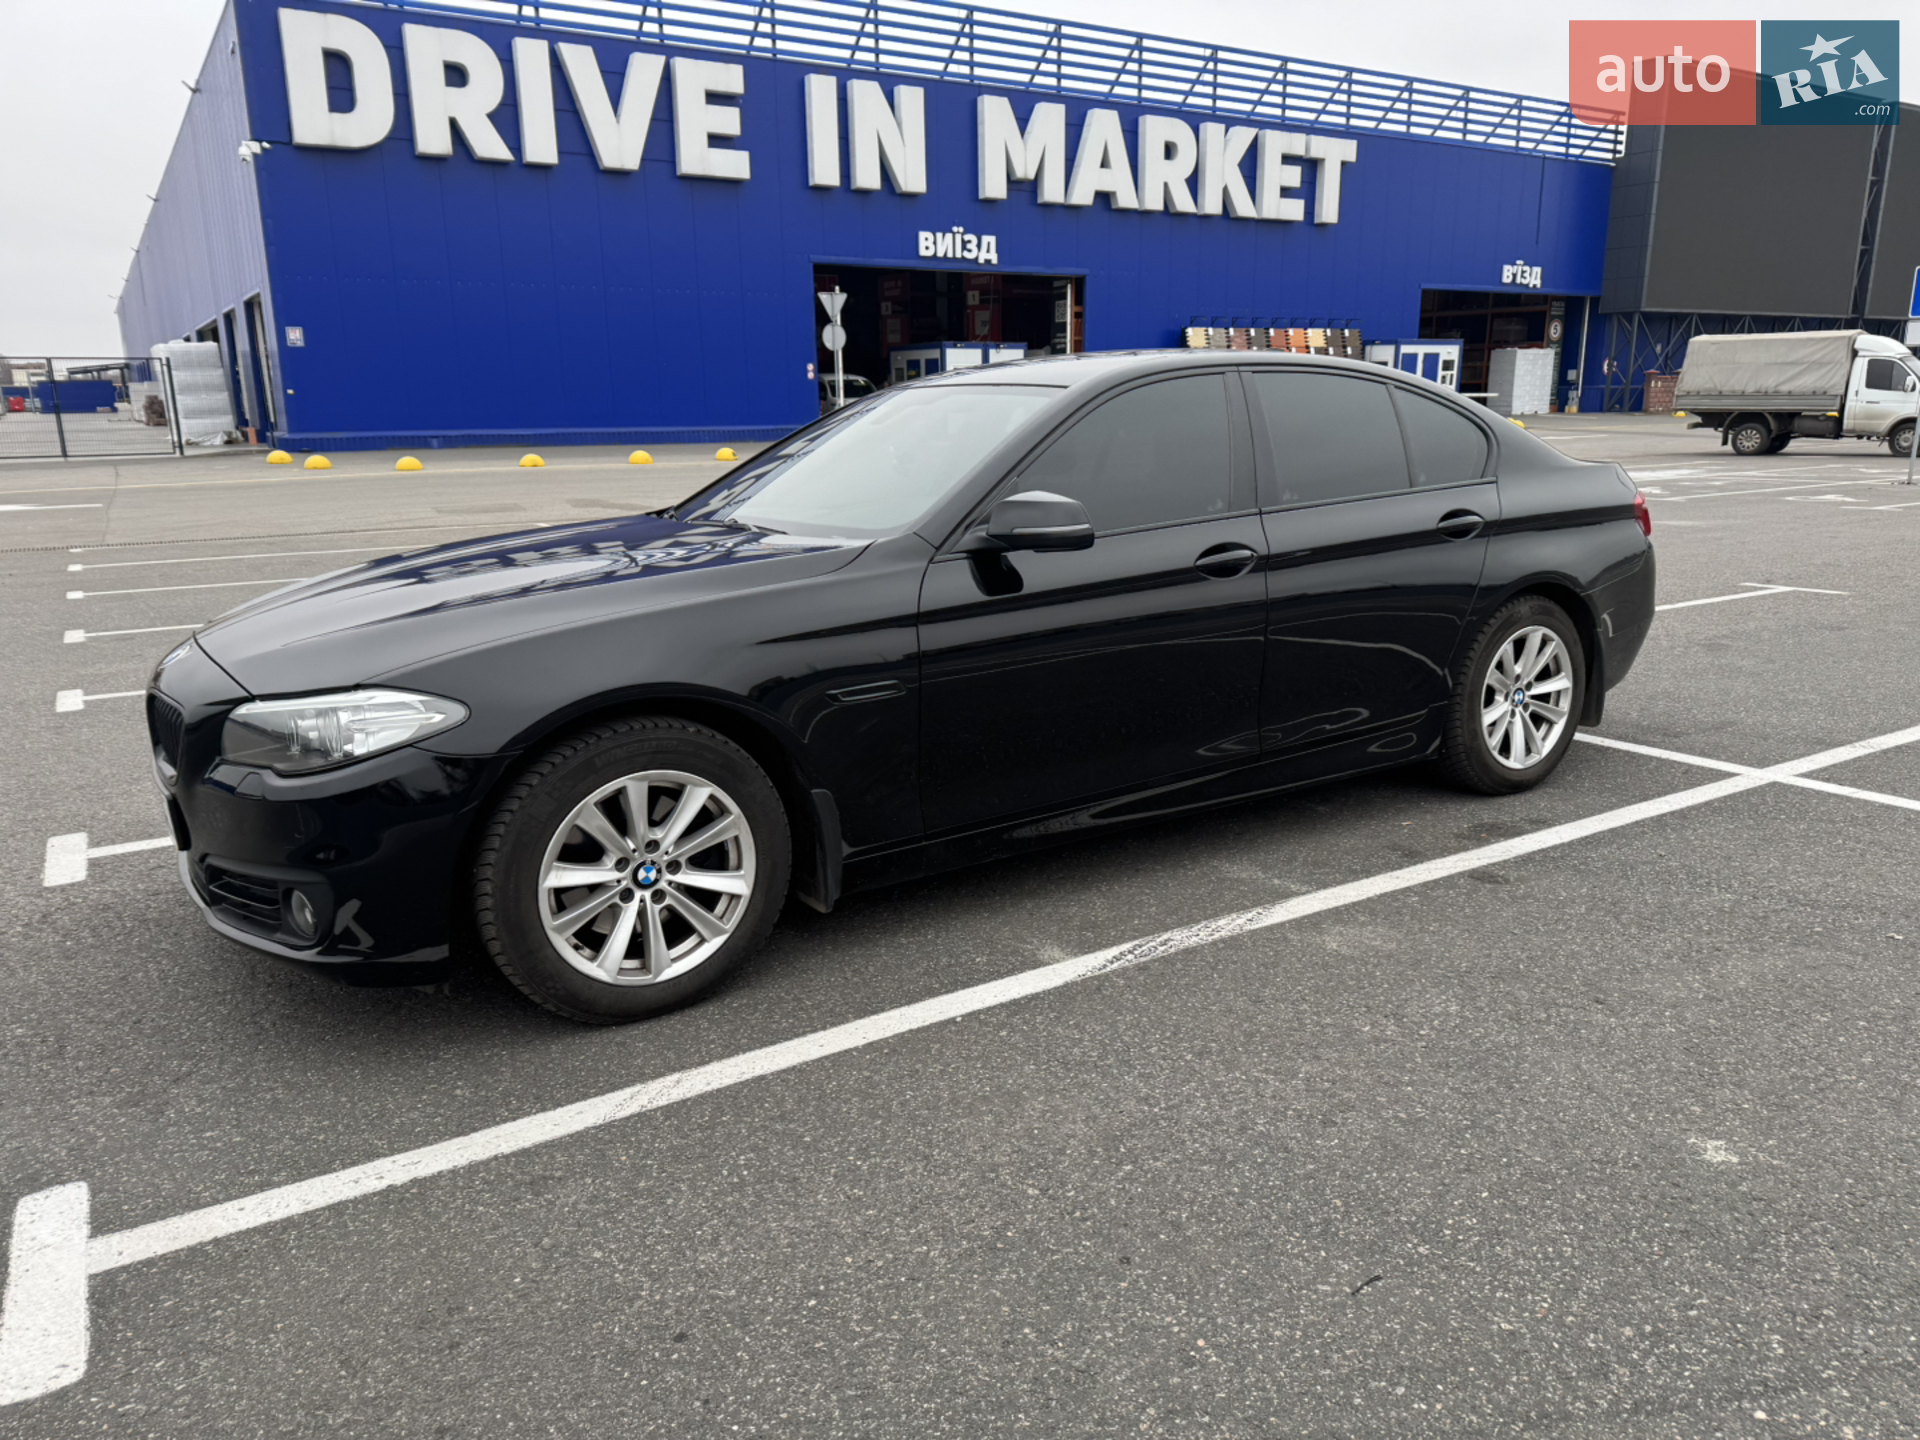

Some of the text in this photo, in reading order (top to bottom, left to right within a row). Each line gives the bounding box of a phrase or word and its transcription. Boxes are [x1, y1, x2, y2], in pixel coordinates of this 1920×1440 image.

[277, 7, 1357, 225] DRIVE IN MARKET
[918, 226, 998, 265] ВИЇЗД
[1501, 259, 1542, 289] В'ЇЗД
